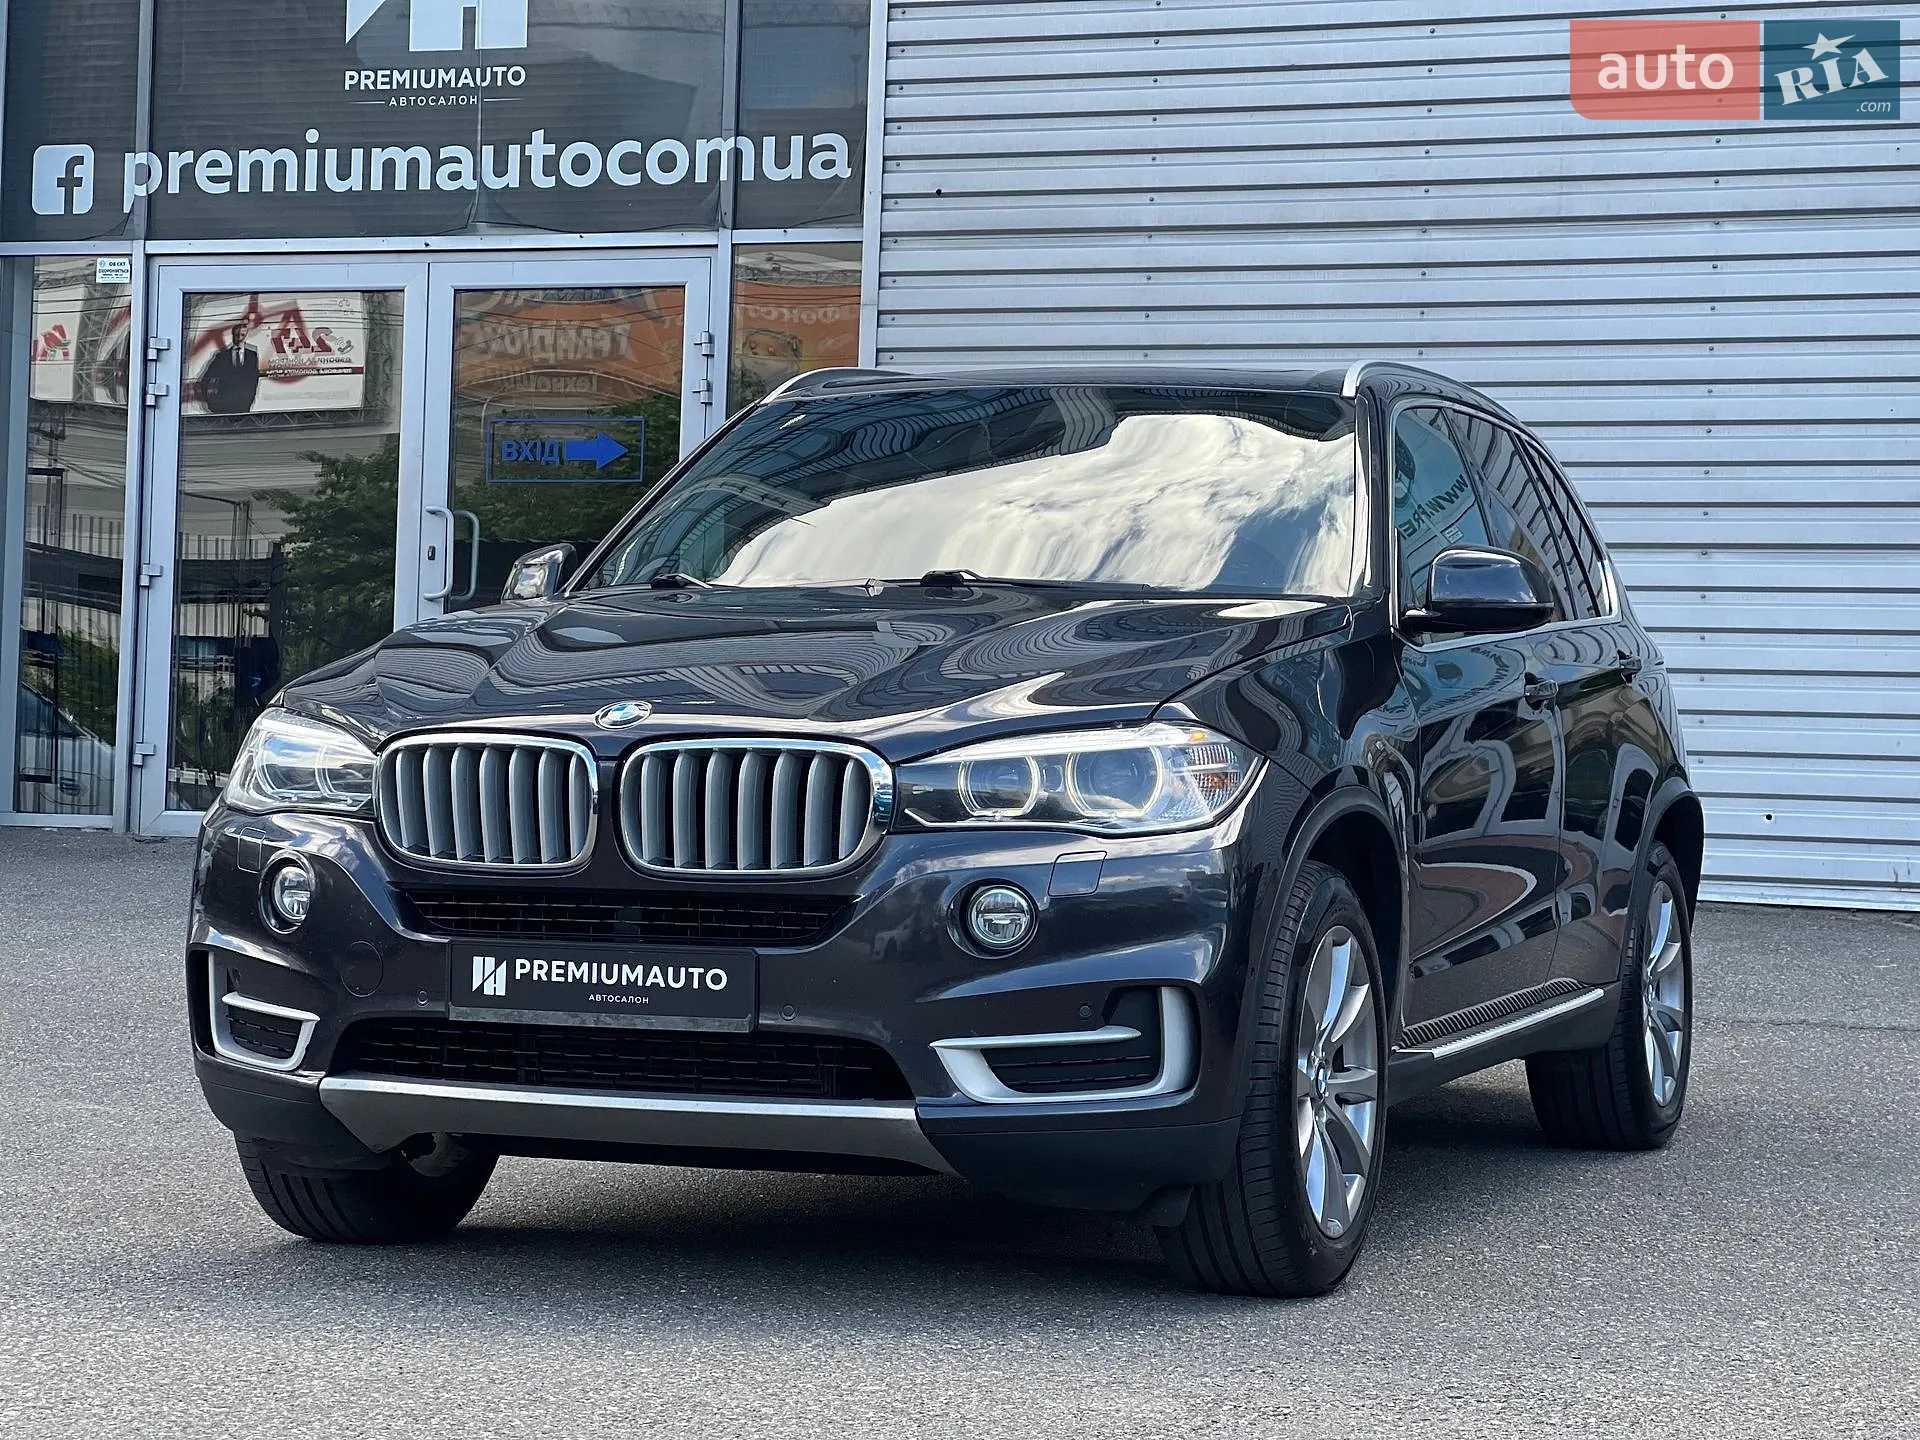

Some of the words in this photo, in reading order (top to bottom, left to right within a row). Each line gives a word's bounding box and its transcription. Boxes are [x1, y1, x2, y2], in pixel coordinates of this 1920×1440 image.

[344, 65, 527, 91] PREMIUMAUTO
[388, 95, 478, 107] АВТОСАЛОН
[123, 128, 852, 214] premiumautocomua
[502, 440, 560, 466] ВХІД
[515, 958, 728, 991] PREMIUMAUTO
[588, 994, 650, 1005] АВТОСАЛОН
